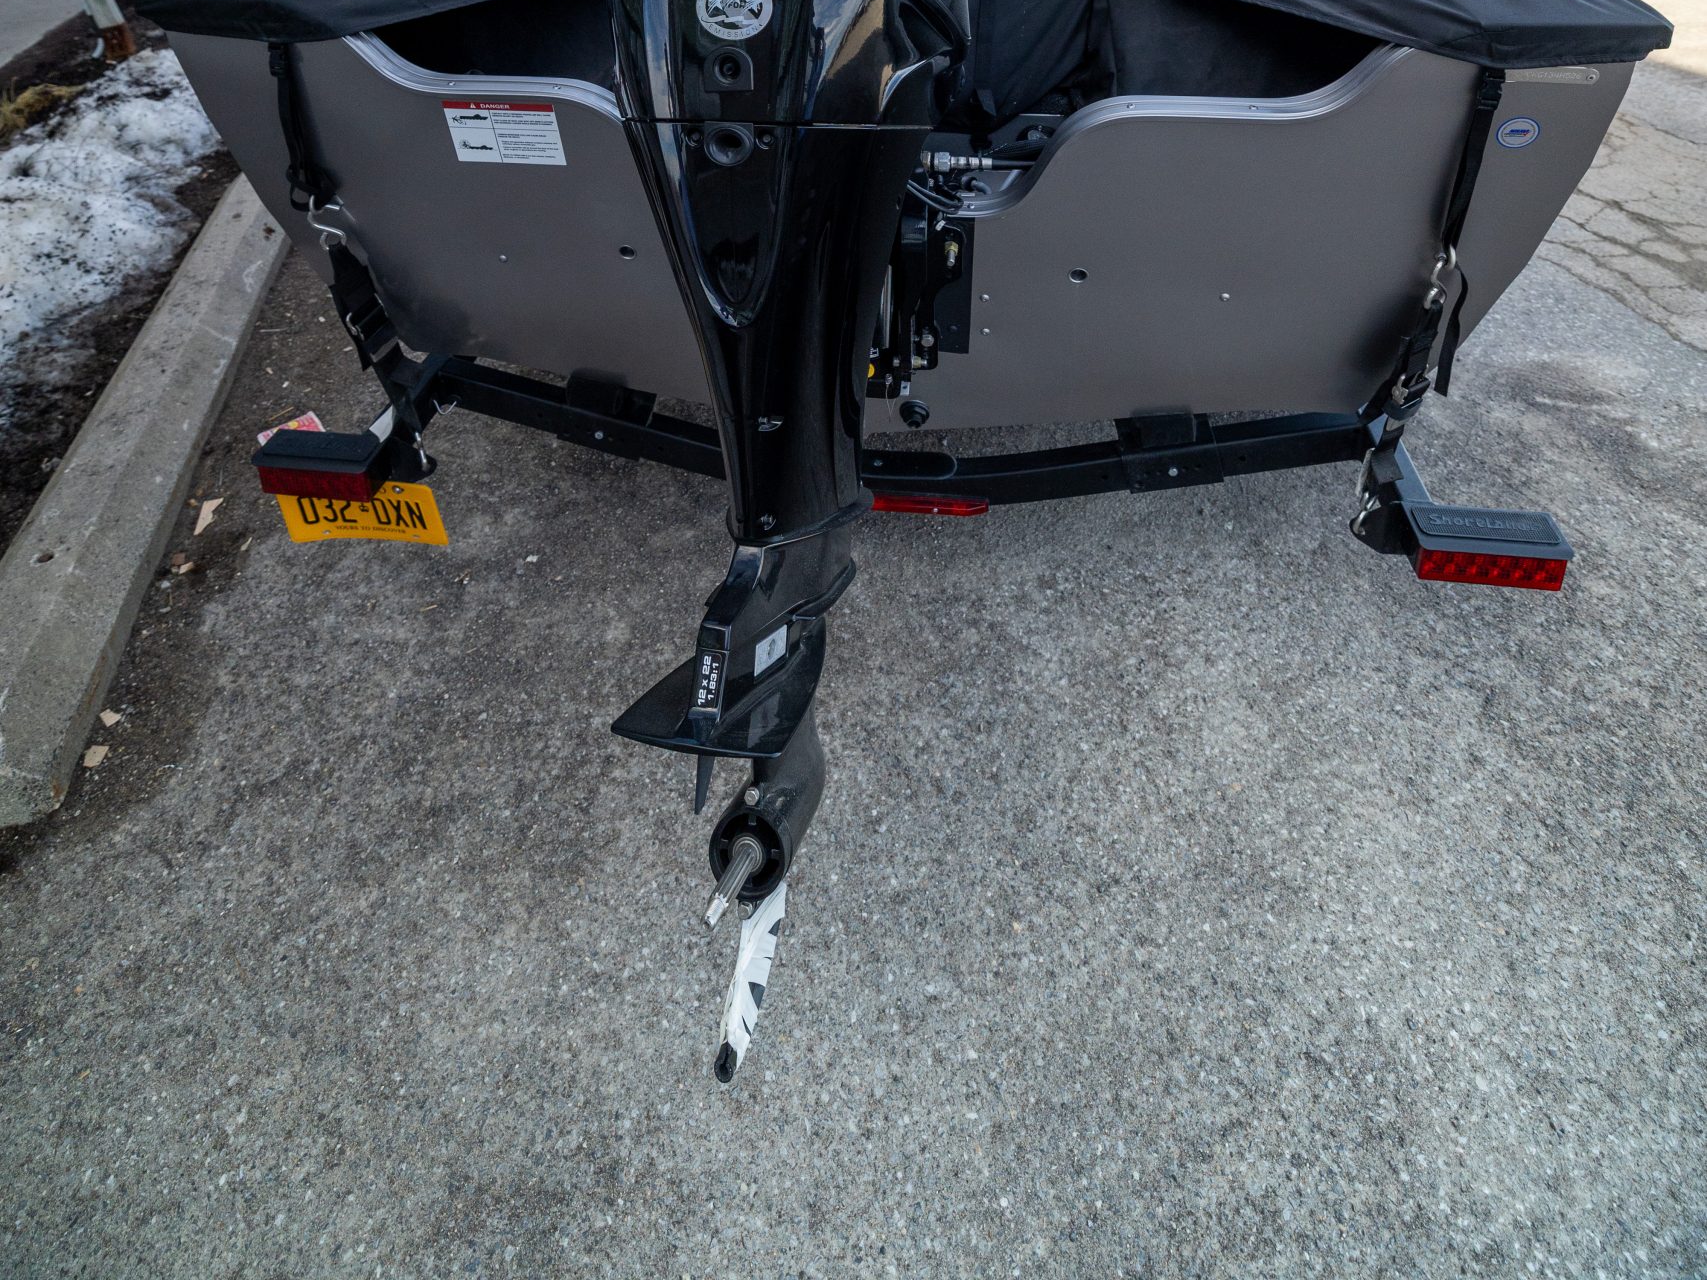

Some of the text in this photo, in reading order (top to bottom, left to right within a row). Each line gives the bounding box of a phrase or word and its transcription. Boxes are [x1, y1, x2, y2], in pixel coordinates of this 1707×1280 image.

[697, 689, 706, 706] 12
[702, 655, 711, 675] 22
[707, 662, 719, 700] 1.83:1
